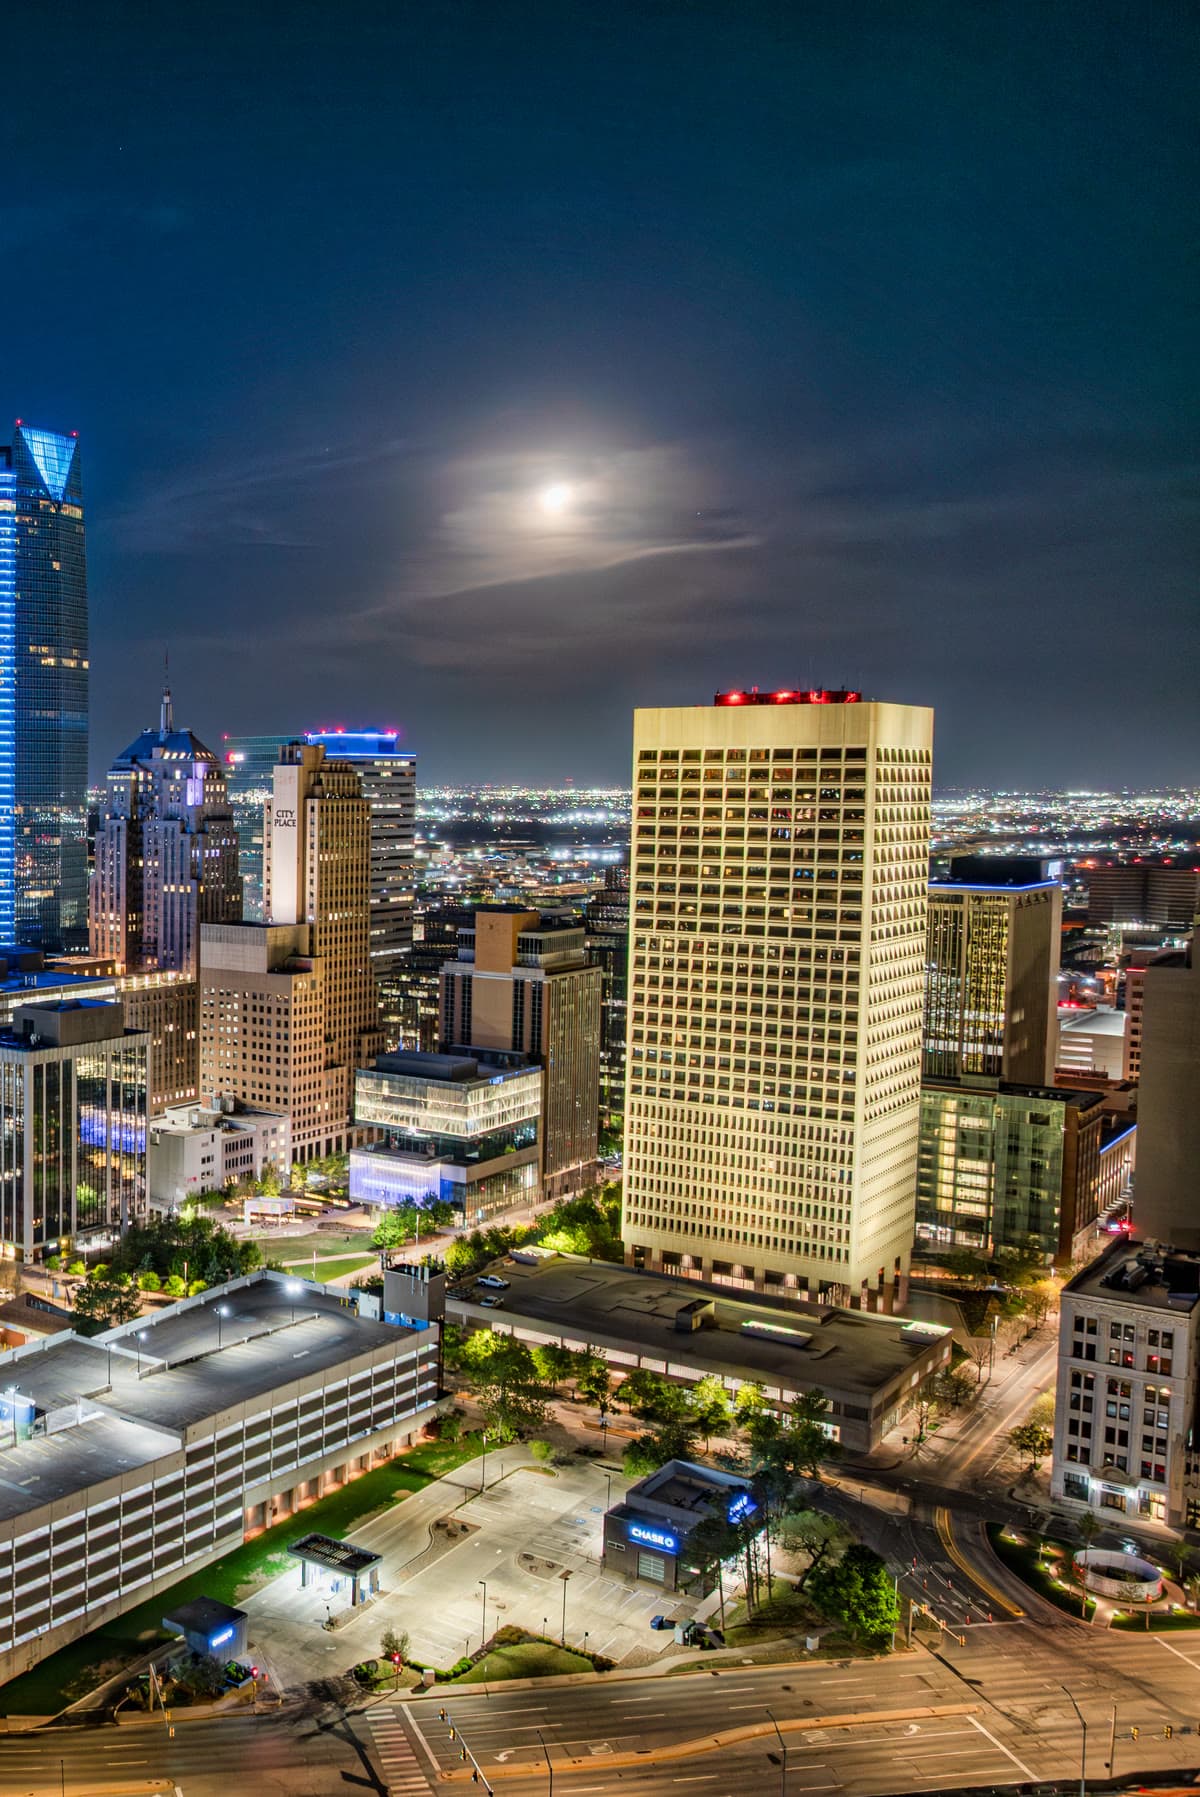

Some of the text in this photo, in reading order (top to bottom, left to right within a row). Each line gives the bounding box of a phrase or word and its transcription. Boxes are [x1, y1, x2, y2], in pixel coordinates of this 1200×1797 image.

[276, 810, 295, 818] CITY
[274, 819, 297, 827] PLACE
[631, 1527, 665, 1546] CHASE
